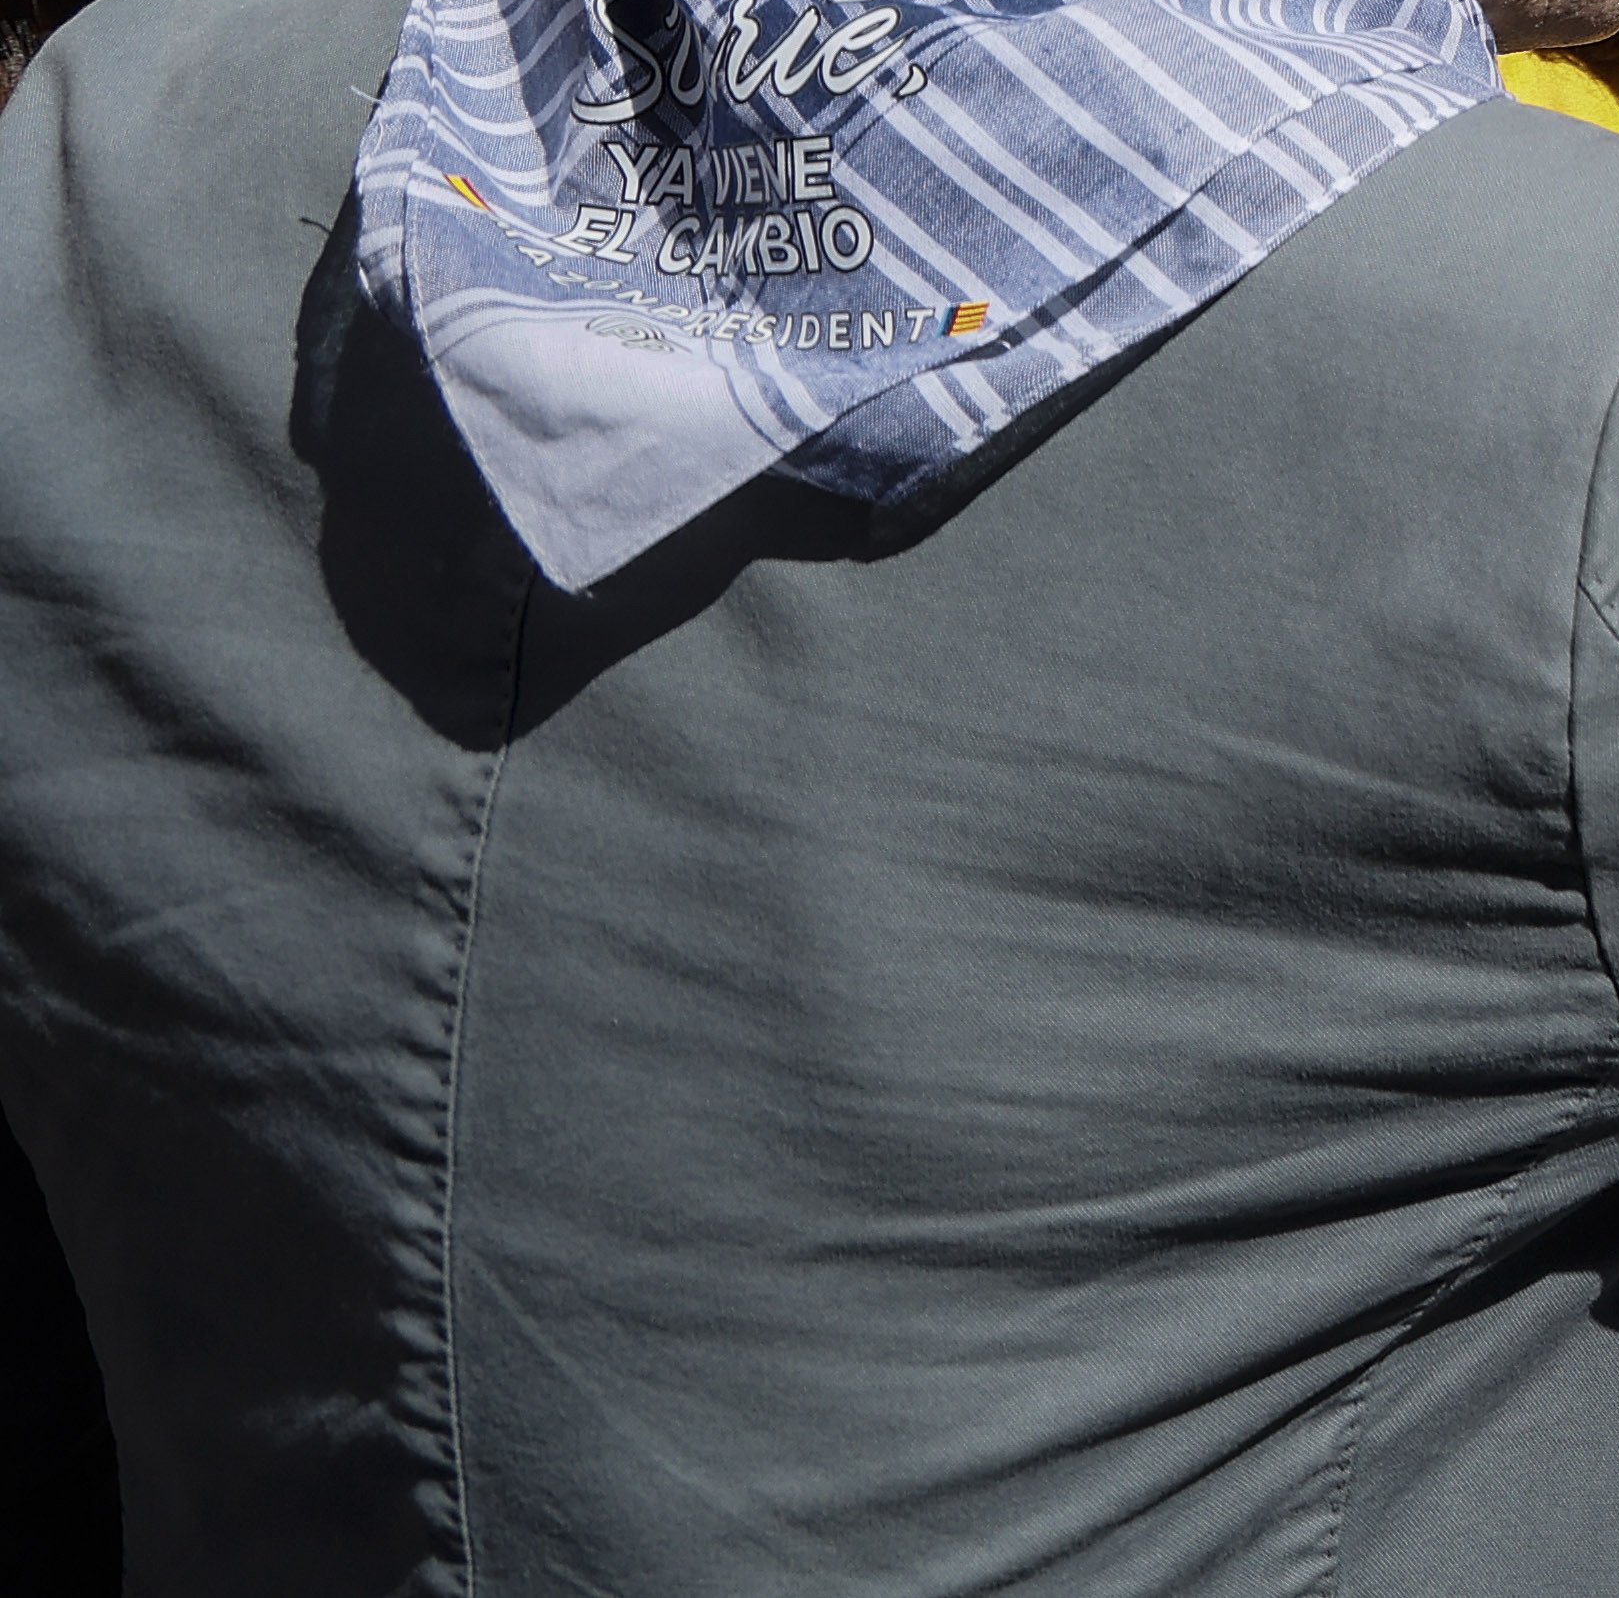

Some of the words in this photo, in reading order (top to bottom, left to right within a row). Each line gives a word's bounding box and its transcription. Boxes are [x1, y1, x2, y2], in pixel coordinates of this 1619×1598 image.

[606, 140, 696, 206] YA
[709, 134, 837, 206] VIENE
[555, 203, 638, 264] EL
[656, 204, 874, 276] CAMBIO
